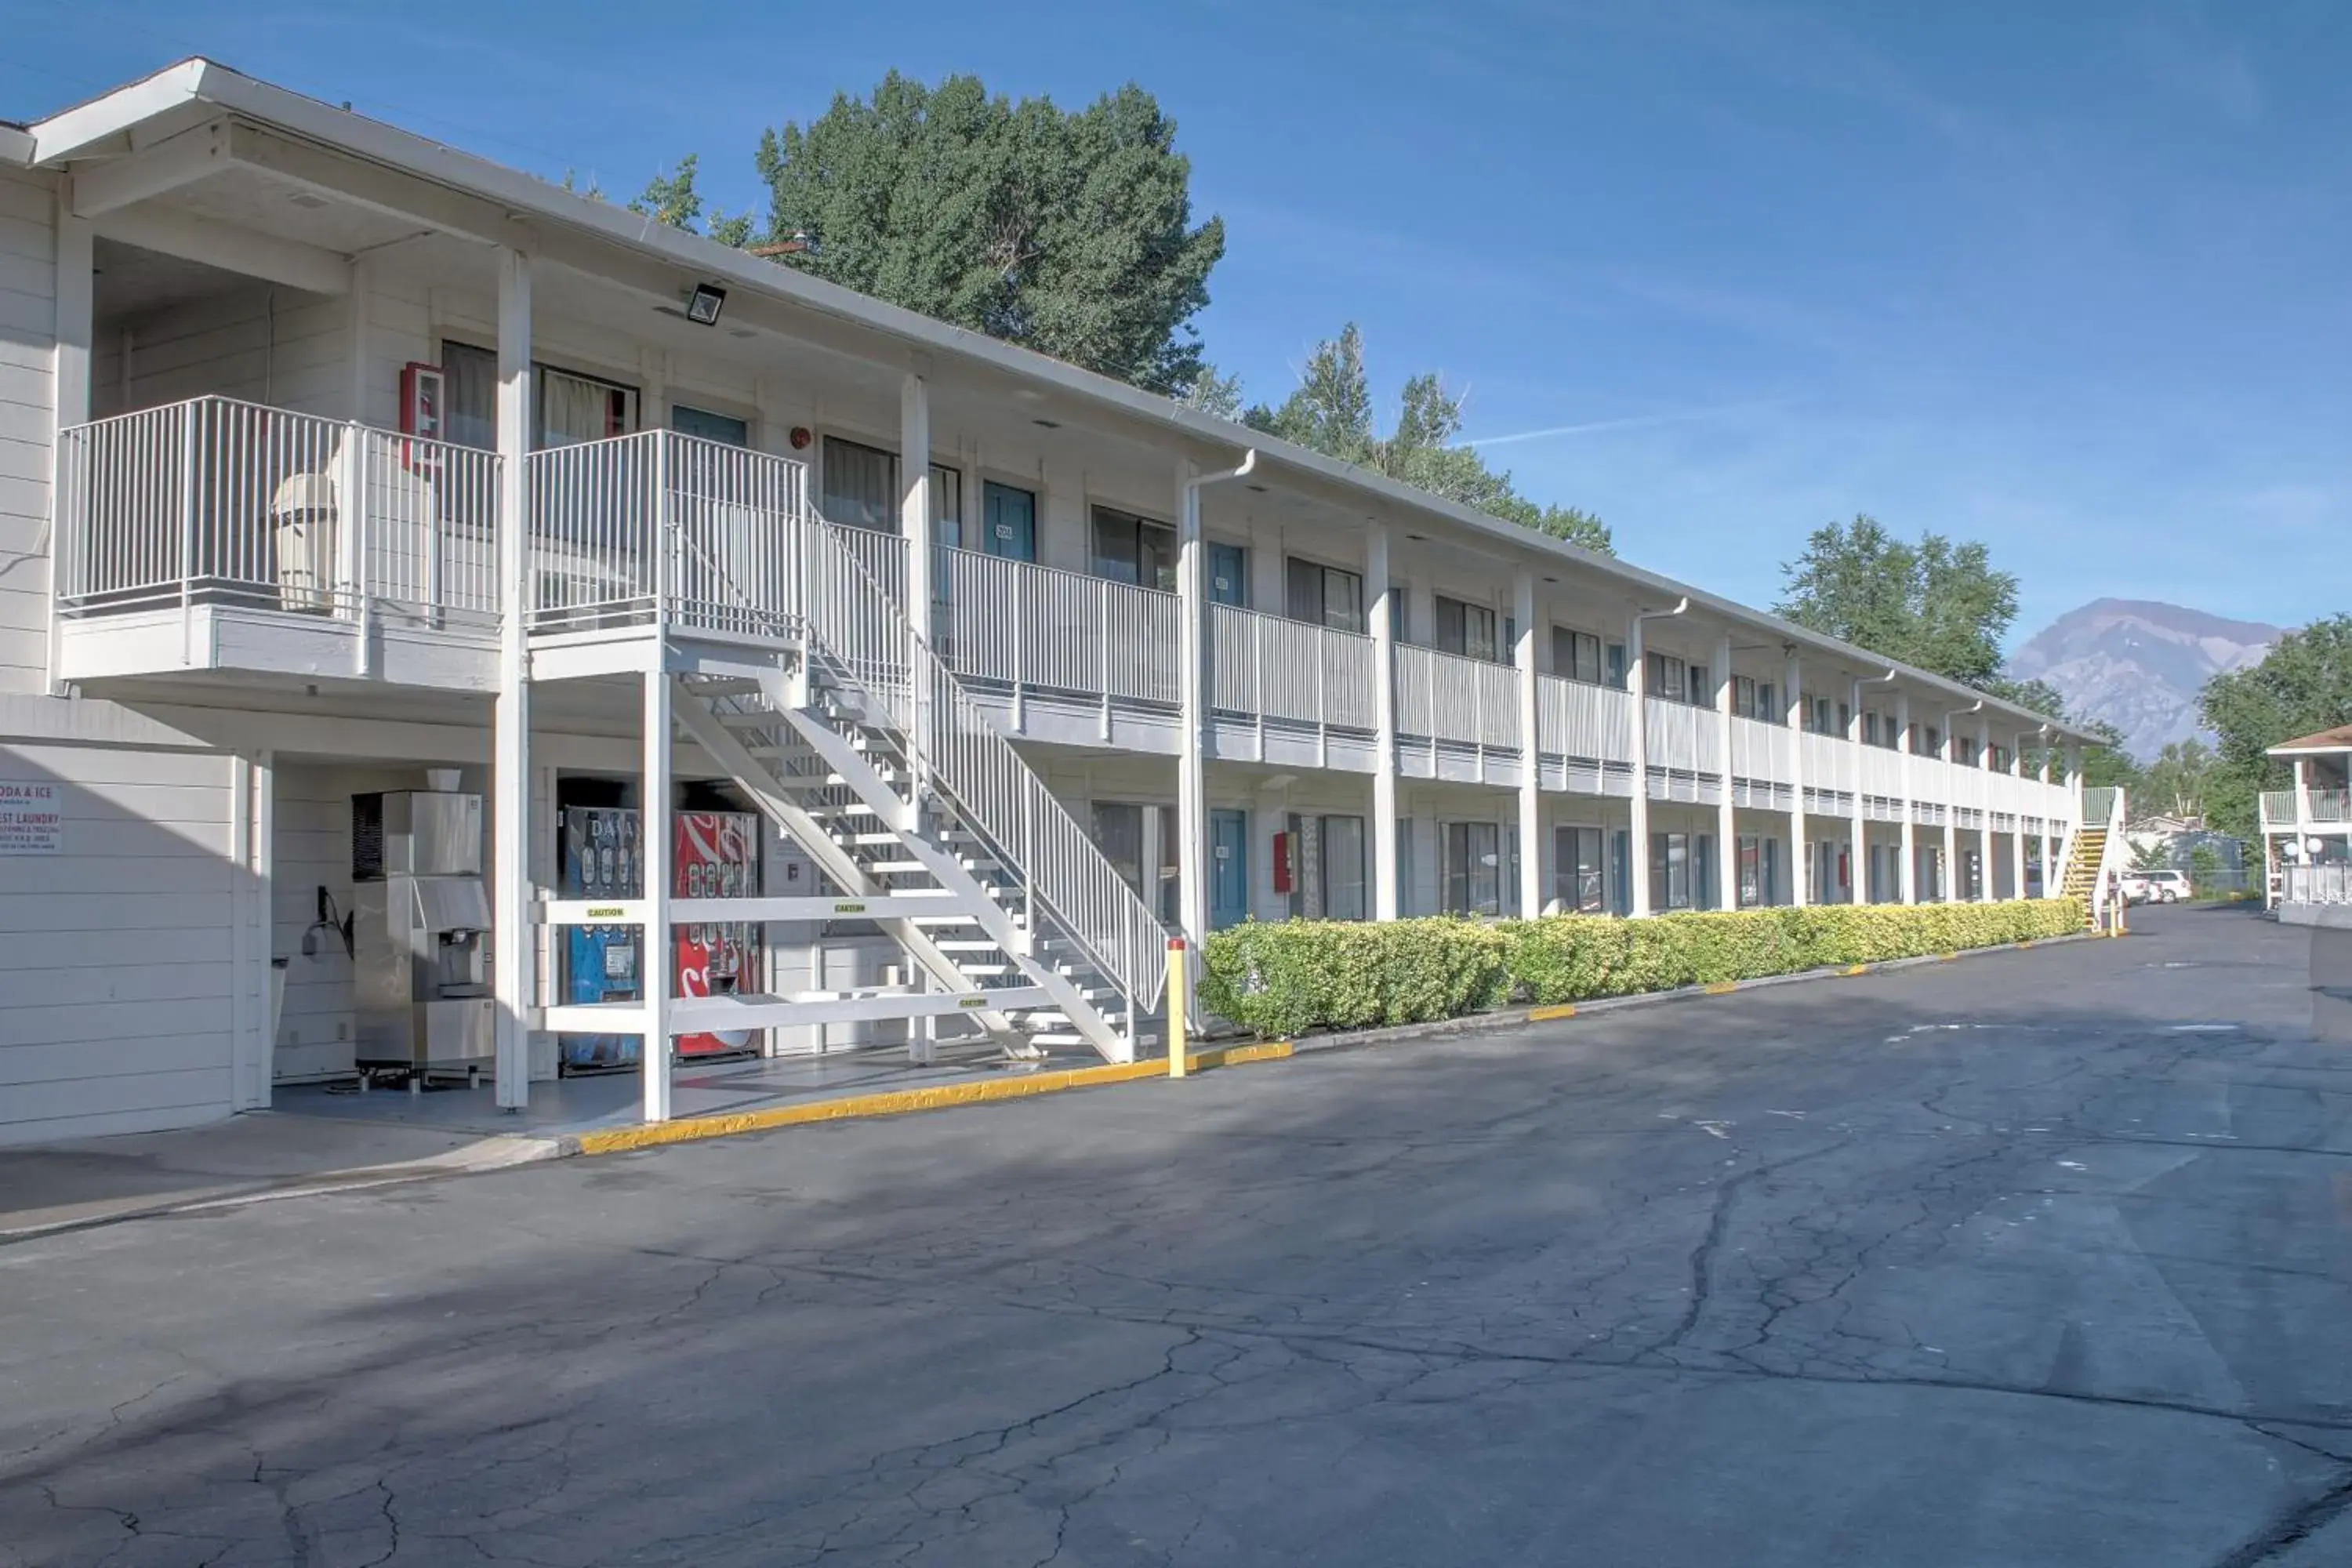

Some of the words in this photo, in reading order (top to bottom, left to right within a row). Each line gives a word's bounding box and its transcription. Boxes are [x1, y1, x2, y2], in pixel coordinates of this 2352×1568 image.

[35, 786, 52, 798] ICE
[16, 812, 59, 824] LAUNDRY
[588, 908, 625, 916] CAUTION
